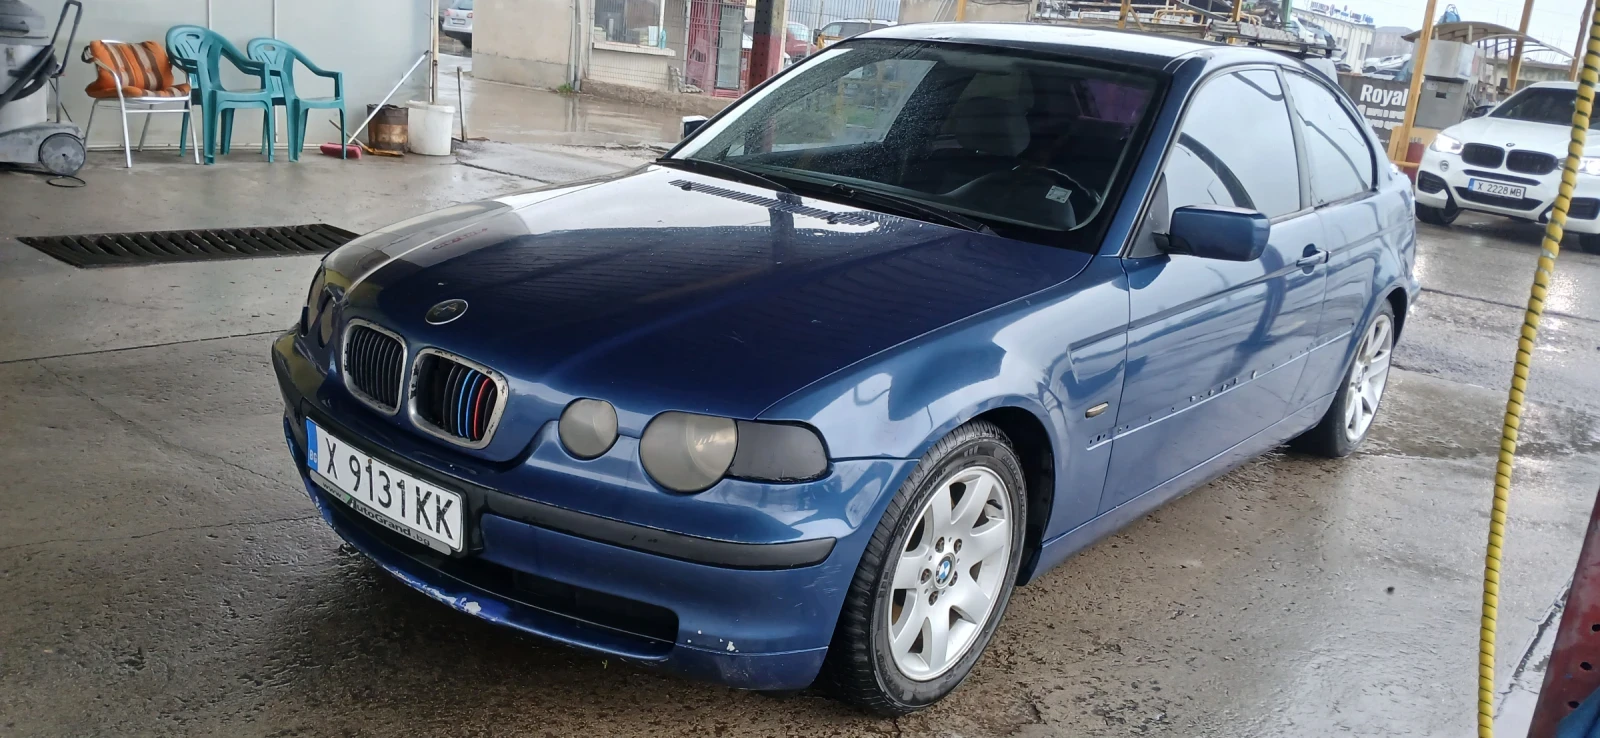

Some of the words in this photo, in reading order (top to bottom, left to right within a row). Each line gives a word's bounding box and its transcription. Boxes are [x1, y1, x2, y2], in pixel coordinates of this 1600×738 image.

[1359, 83, 1409, 107] Royal
[1487, 184, 1509, 195] 2228
[309, 448, 318, 464] BG
[326, 437, 338, 481] X
